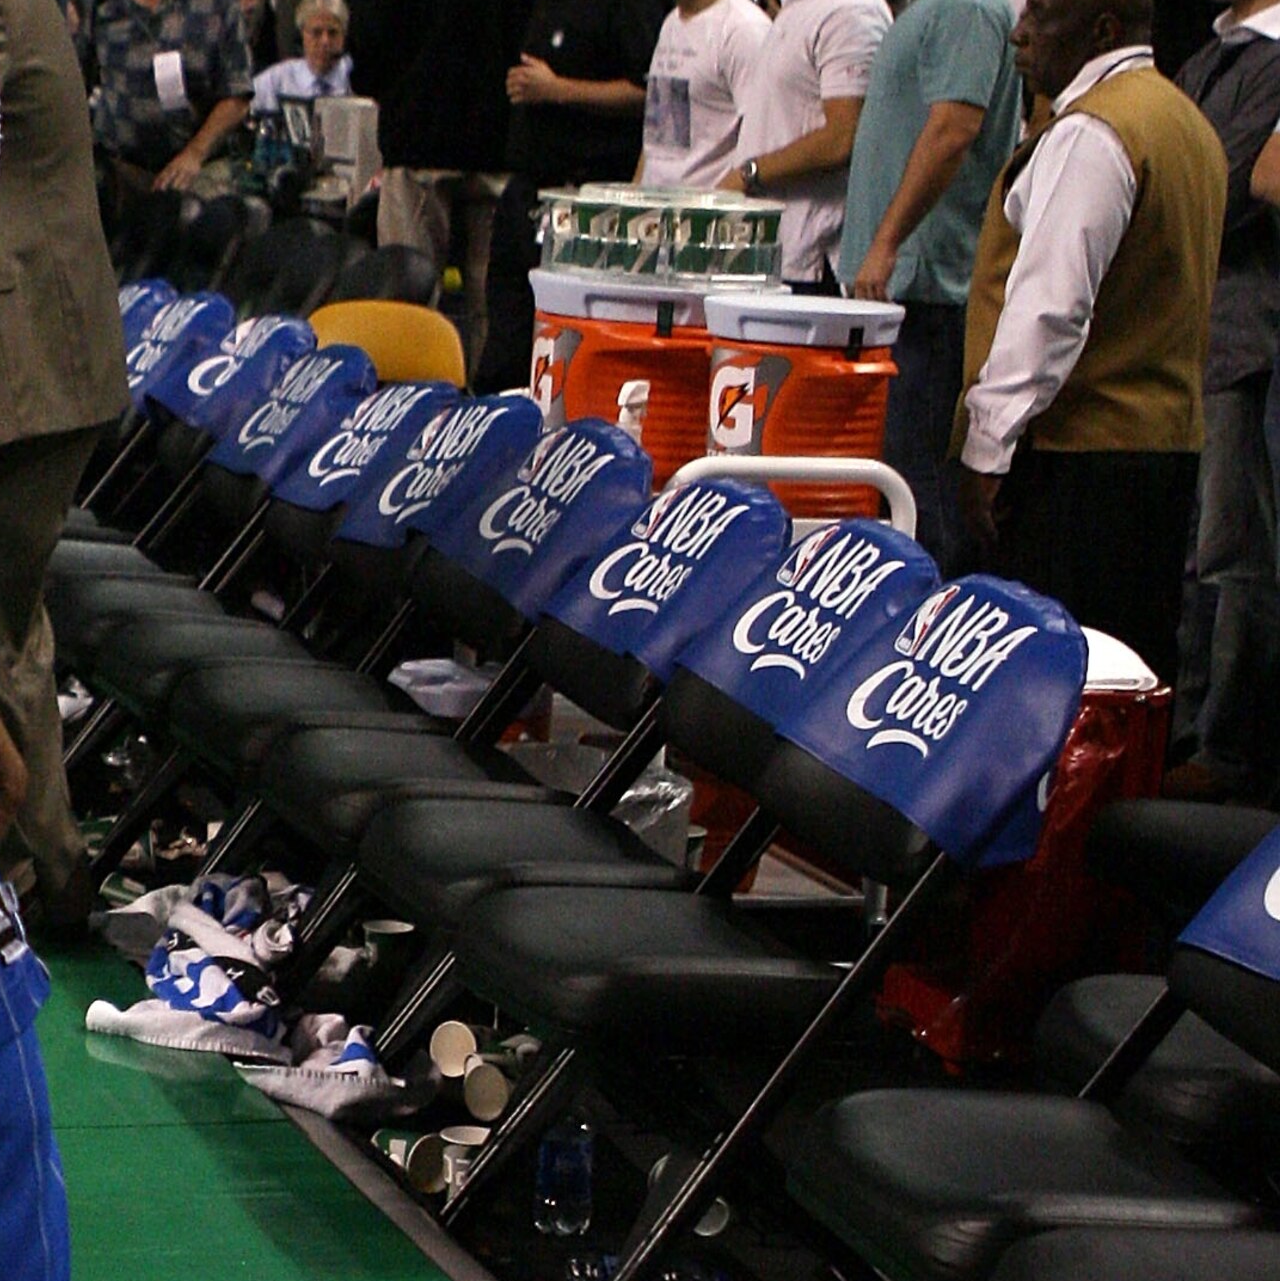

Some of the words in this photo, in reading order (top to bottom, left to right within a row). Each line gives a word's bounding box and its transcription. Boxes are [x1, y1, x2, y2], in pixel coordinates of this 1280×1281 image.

[355, 385, 434, 431] NBA
[423, 405, 510, 460] NBA
[710, 365, 756, 449] G
[531, 432, 615, 505] NBA
[655, 486, 751, 560] NBA
[589, 543, 694, 603] Cares
[800, 532, 907, 620] NBA
[732, 591, 841, 664] Cares
[914, 593, 1039, 692] NBA
[846, 660, 969, 741] Cares
